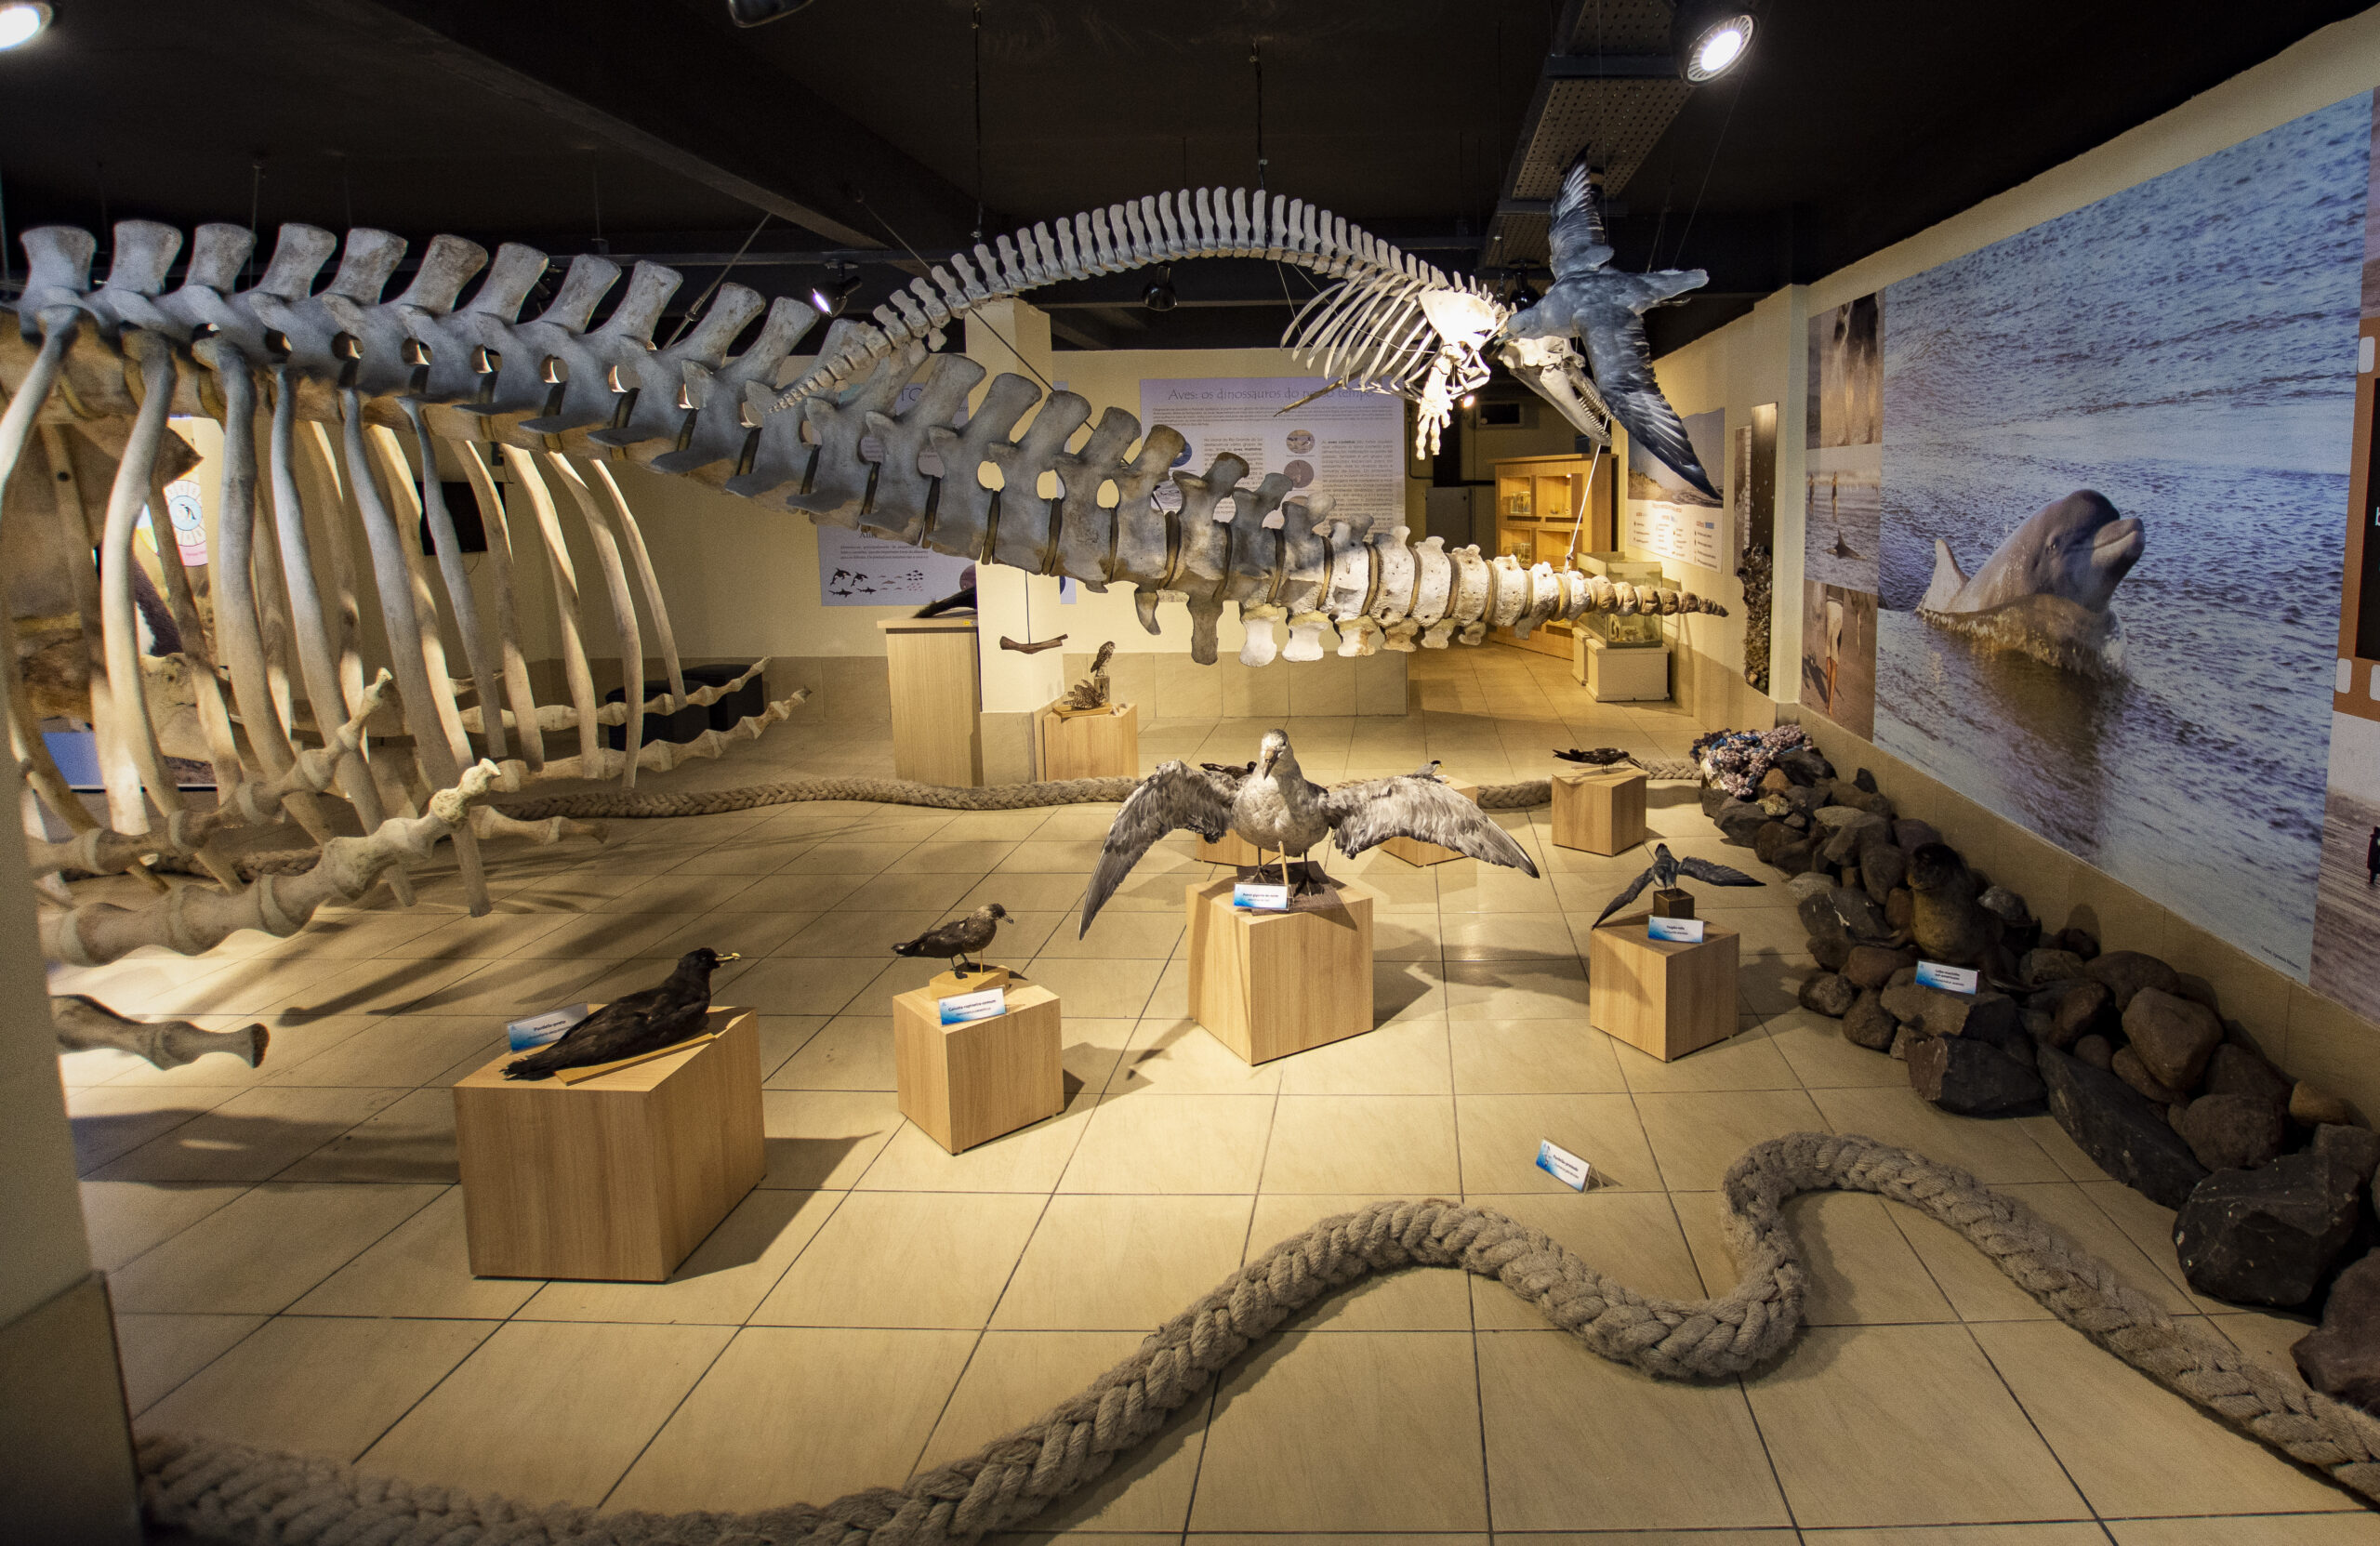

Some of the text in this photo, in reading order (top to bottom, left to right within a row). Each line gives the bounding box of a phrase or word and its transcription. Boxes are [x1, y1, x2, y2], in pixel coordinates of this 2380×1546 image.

[1168, 389, 1198, 401] Aves:
[1201, 391, 1214, 400] os
[1216, 389, 1281, 401] dinossauros
[1284, 387, 1300, 400] do
